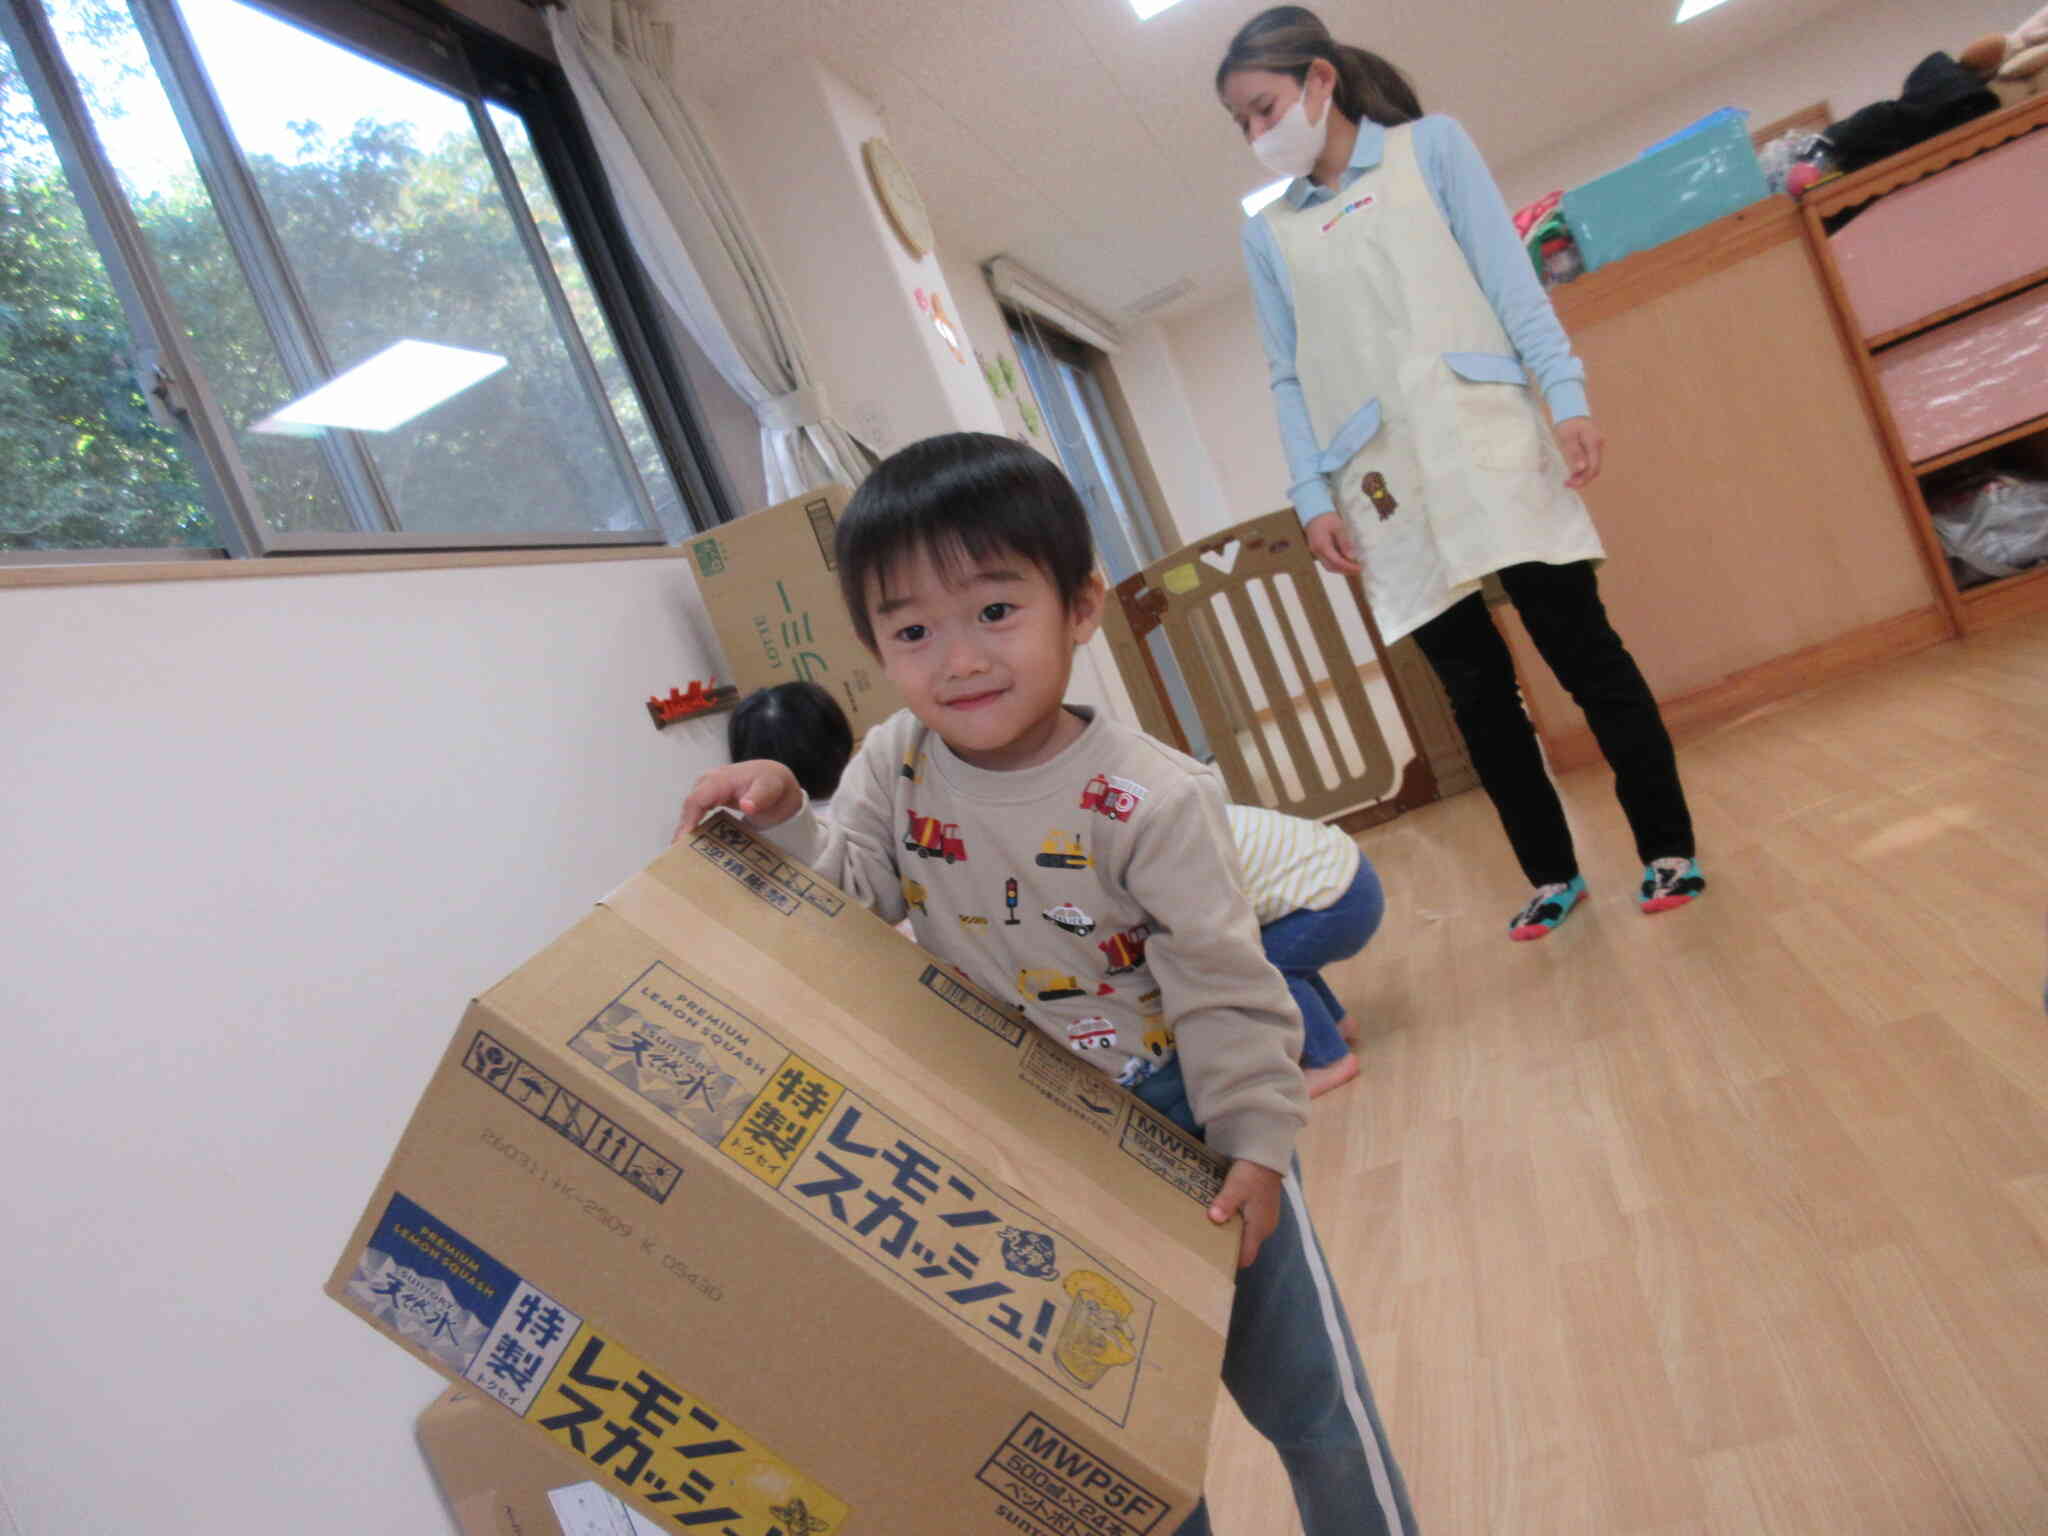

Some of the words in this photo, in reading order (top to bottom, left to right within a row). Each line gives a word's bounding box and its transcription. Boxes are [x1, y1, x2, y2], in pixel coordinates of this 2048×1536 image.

[640, 986, 698, 1028] LEMON
[702, 1027, 767, 1076] SQUASH
[676, 994, 749, 1046] PREMIUM
[608, 1031, 715, 1113] 天然水
[743, 1066, 831, 1162] 特製
[731, 1137, 784, 1176] トクセイ
[827, 1105, 1001, 1229] レモン
[394, 1223, 441, 1260] LEMON
[441, 1255, 497, 1298] SQUASH
[420, 1226, 480, 1273] PREMIUM
[371, 1272, 460, 1347] 天然水
[486, 1292, 566, 1393] 特製
[474, 1373, 521, 1406] トクセイ
[567, 1335, 747, 1460] レモン
[536, 1383, 785, 1536] スカッシ
[1022, 1426, 1154, 1517] MWP5F
